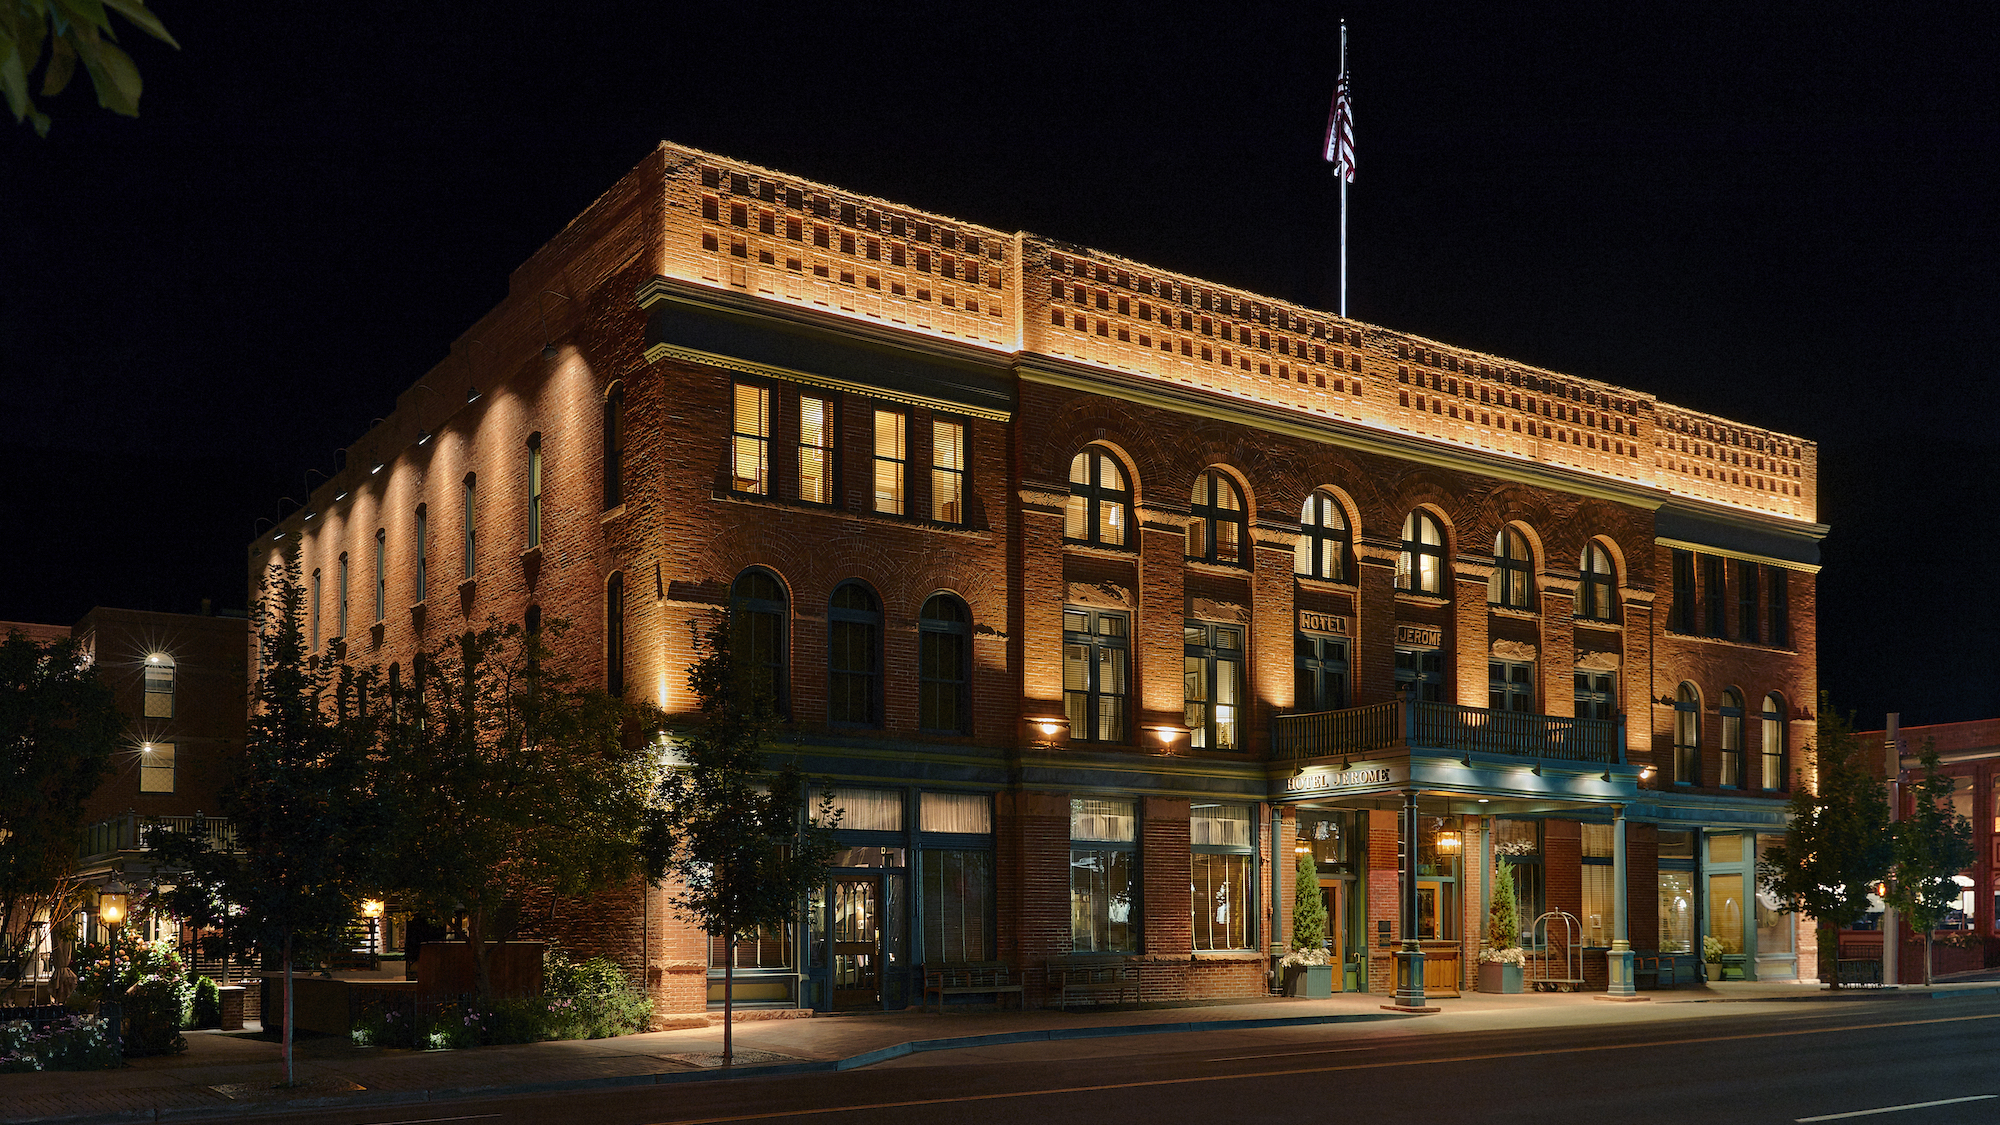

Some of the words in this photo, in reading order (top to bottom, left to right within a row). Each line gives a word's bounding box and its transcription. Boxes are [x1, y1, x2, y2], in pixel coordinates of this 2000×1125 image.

[1302, 613, 1346, 633] HOTEL
[1400, 628, 1442, 646] JEROME
[1287, 775, 1329, 790] HOTEL
[1333, 768, 1389, 786] JEROME
